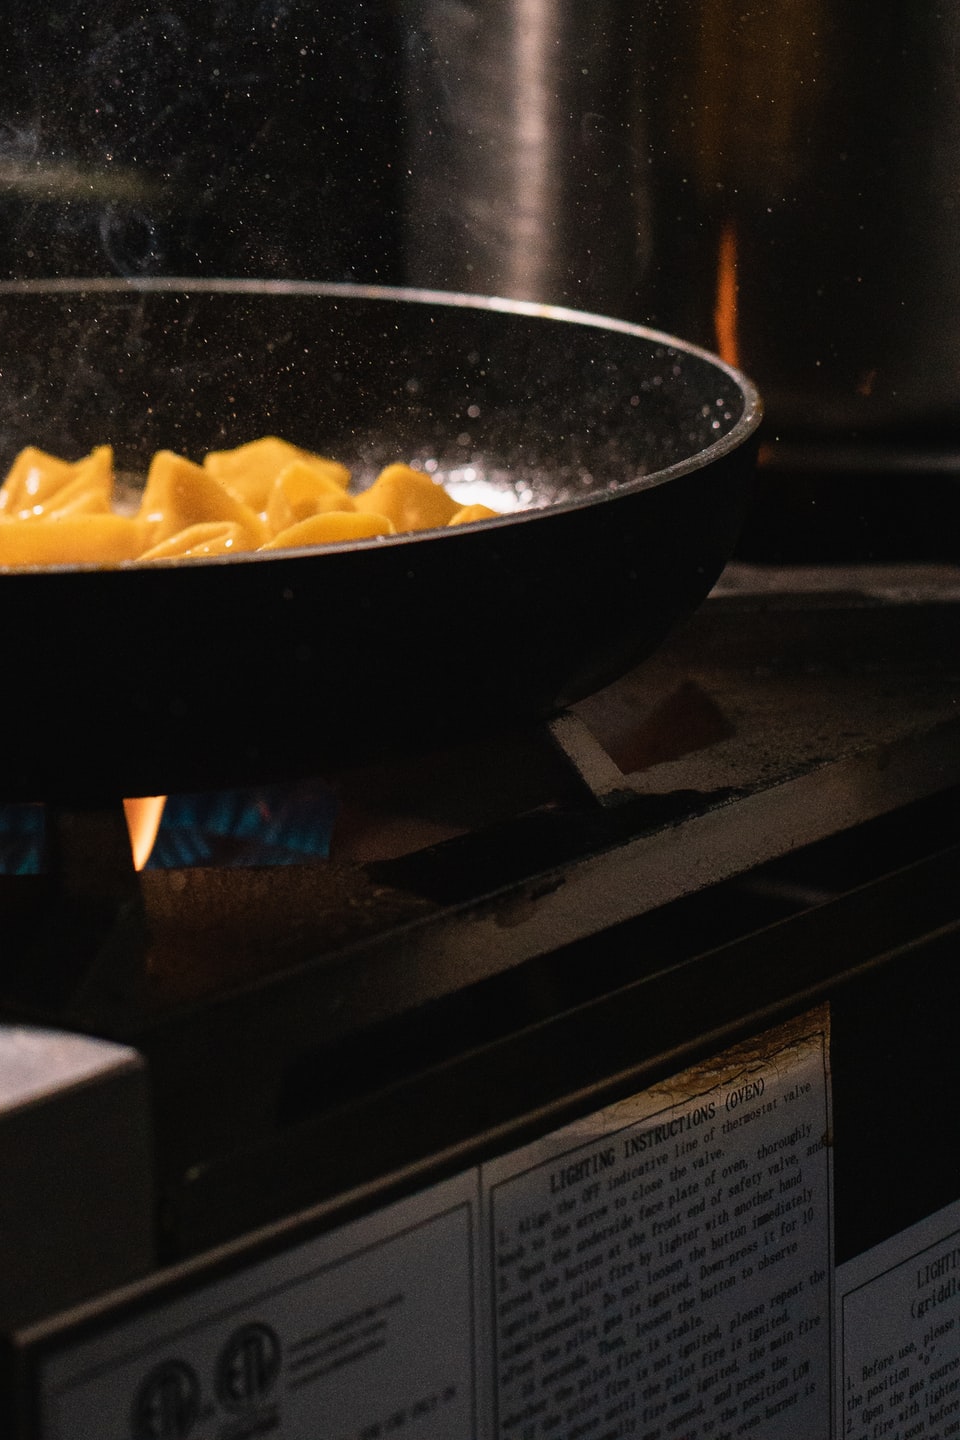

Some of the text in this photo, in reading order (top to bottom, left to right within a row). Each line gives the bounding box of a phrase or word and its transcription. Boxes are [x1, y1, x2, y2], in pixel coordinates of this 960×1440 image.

[550, 1077, 765, 1194] LIGHTING INSTRUCTIONS (OVEN)
[608, 1153, 669, 1191] indicative
[675, 1139, 698, 1158] line
[703, 1126, 716, 1144] of
[721, 1098, 777, 1135] thermostat
[783, 1082, 812, 1103] valve
[608, 1244, 621, 1260] at
[627, 1232, 646, 1249] the
[651, 1212, 681, 1237] front
[687, 1197, 706, 1218] end
[710, 1188, 723, 1207] of
[728, 1171, 763, 1198] safety
[767, 1154, 799, 1176] valve,
[806, 1137, 824, 1157] and
[614, 1196, 628, 1210] to
[631, 1178, 664, 1202] close
[669, 1166, 687, 1182] the
[692, 1148, 725, 1170] valve.
[639, 1201, 664, 1221] face
[668, 1182, 699, 1209] plate
[704, 1169, 717, 1188] of
[721, 1159, 749, 1179] oven,
[757, 1124, 812, 1160] thoroughly
[570, 1276, 603, 1305] pilot
[609, 1261, 635, 1283] fire
[639, 1251, 653, 1267] by
[659, 1227, 700, 1257] lighter
[704, 1209, 729, 1232] with
[734, 1188, 775, 1217] another
[779, 1170, 803, 1194] hand
[621, 1280, 640, 1298] not
[647, 1258, 683, 1286] loosen
[688, 1246, 707, 1263] the
[711, 1225, 747, 1251] button
[752, 1188, 813, 1230] immediately
[629, 1303, 642, 1319] is
[699, 1241, 758, 1280] Down-press
[764, 1230, 775, 1246] it
[780, 1219, 798, 1237] for
[802, 1208, 814, 1225] 10
[635, 1310, 672, 1338] loosen
[677, 1297, 696, 1314] the
[700, 1275, 736, 1302] button
[741, 1266, 754, 1280] to
[758, 1242, 798, 1271] observe
[605, 1378, 630, 1399] fire
[636, 1367, 649, 1382] is
[653, 1353, 672, 1373] not
[678, 1324, 722, 1359] ignited,
[729, 1303, 765, 1334] please
[770, 1281, 803, 1309] repeat
[809, 1270, 826, 1286] the
[616, 1349, 642, 1370] fire
[648, 1338, 660, 1354] is
[665, 1316, 705, 1344] stable.
[642, 1383, 661, 1400] the
[665, 1363, 696, 1391] pilot
[701, 1347, 726, 1369] fire
[731, 1337, 743, 1353] is
[748, 1309, 791, 1343] ignited.
[748, 1346, 766, 1364] the
[770, 1330, 794, 1352] main
[798, 1315, 821, 1336] fire
[847, 1318, 955, 1391] 1. Before use, please
[702, 1360, 811, 1433] to the position LOW
[713, 1383, 732, 1406] and
[736, 1368, 766, 1395] press
[771, 1356, 788, 1373] the
[736, 1415, 761, 1435] oven
[765, 1392, 798, 1420] burner
[804, 1382, 816, 1398] is
[846, 1418, 855, 1435] 2.
[861, 1403, 884, 1424] Open
[889, 1391, 905, 1408] the
[908, 1378, 925, 1399] gas
[847, 1394, 863, 1412] the
[867, 1367, 910, 1403] position
[872, 1418, 894, 1440] fire
[898, 1400, 920, 1422] with
[904, 1421, 925, 1440] soon
